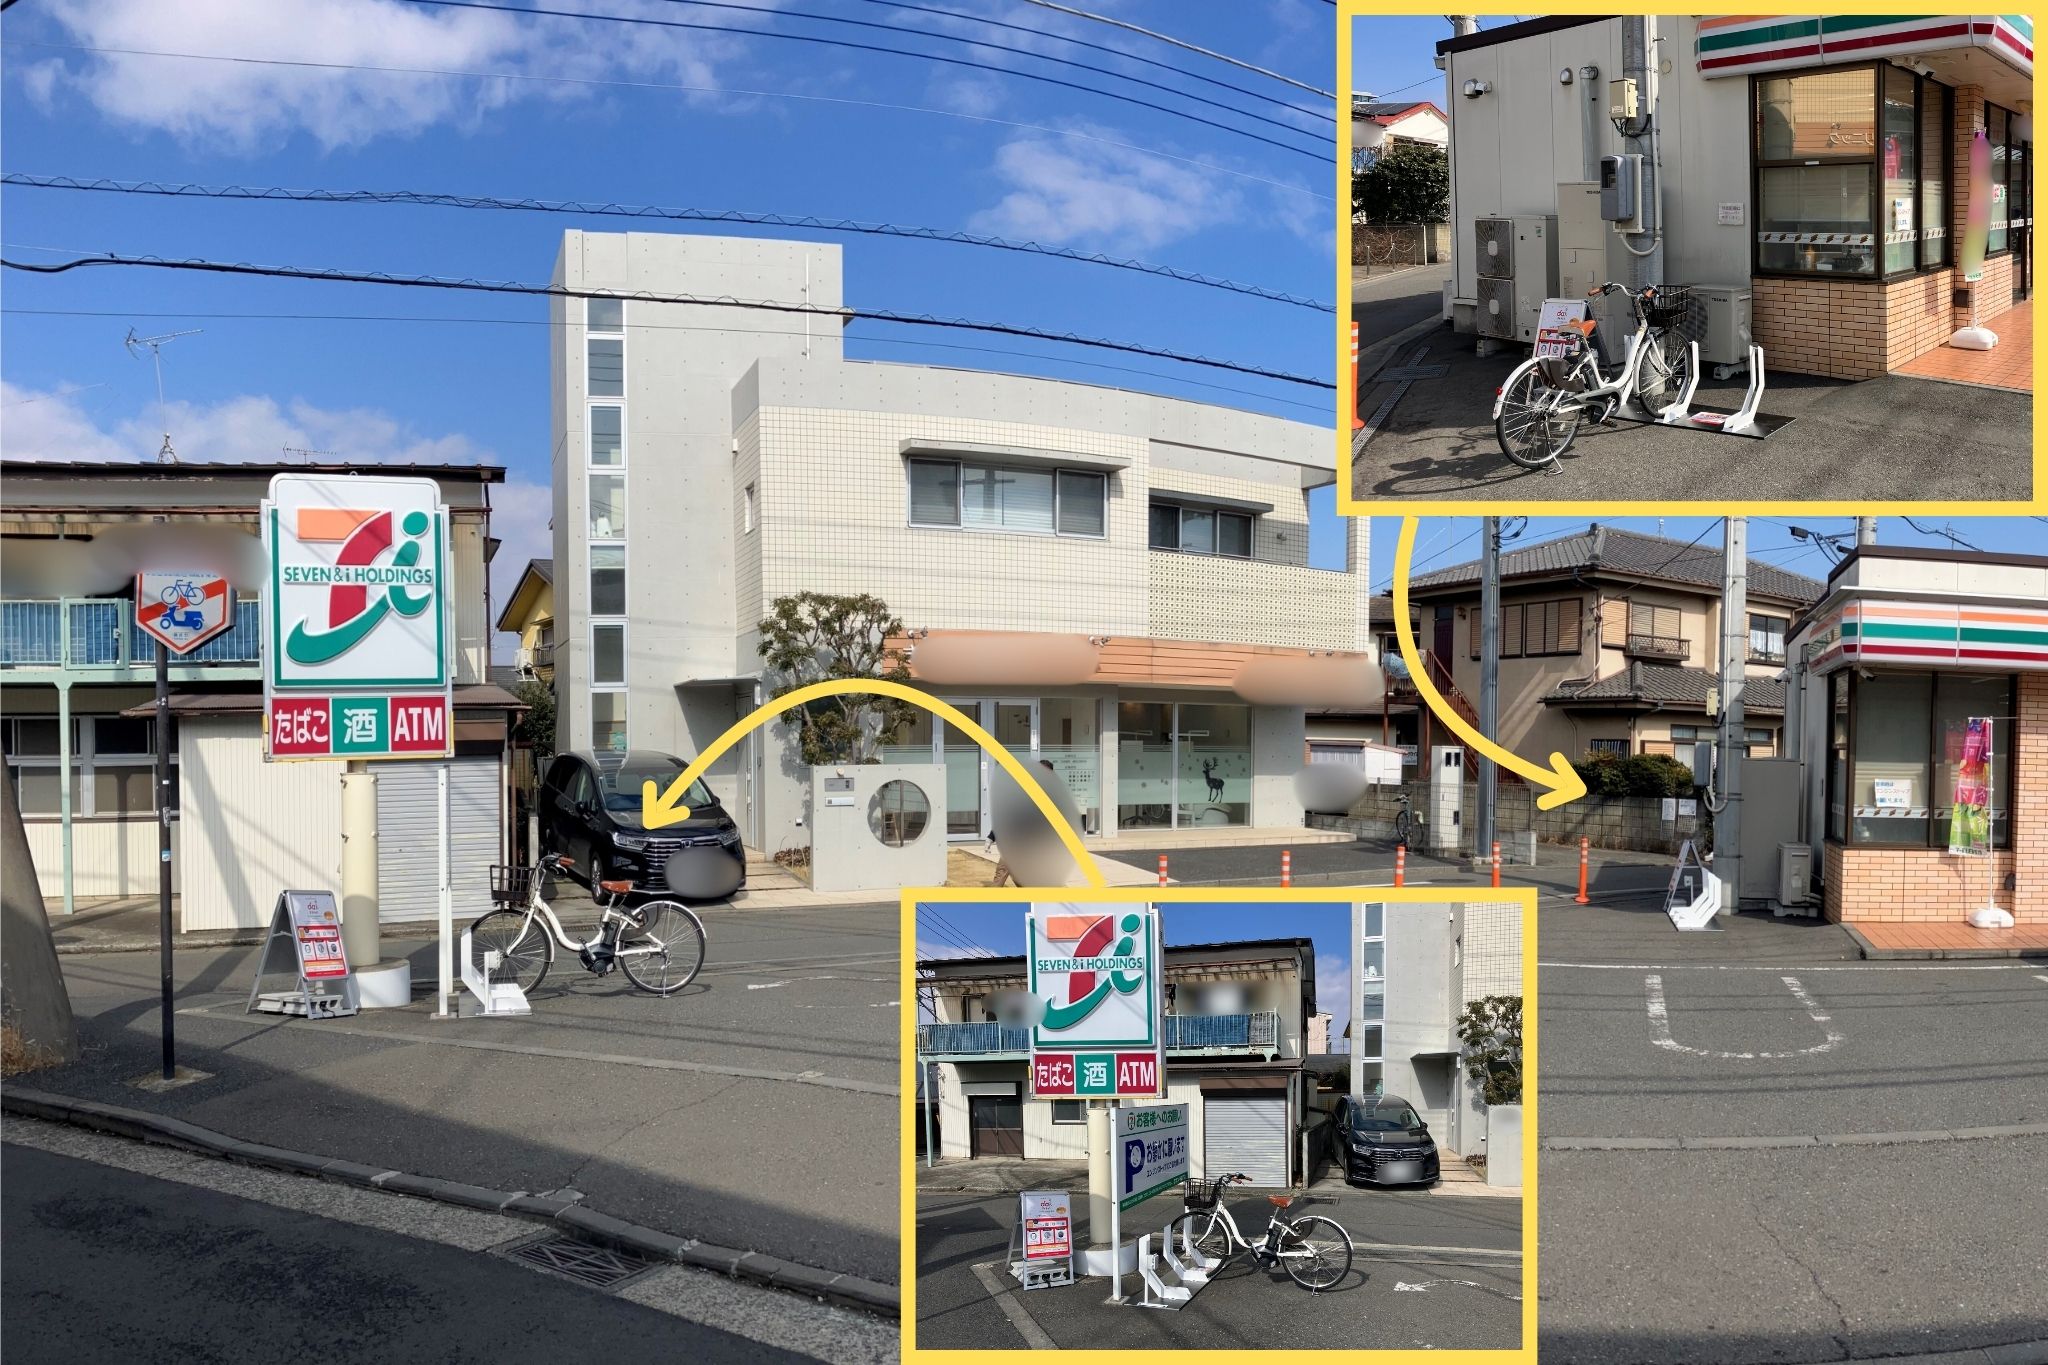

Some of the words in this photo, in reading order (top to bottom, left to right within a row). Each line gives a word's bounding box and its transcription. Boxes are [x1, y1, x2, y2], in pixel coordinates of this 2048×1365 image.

[355, 567, 432, 583] HOLDINGS
[275, 707, 329, 745] たばこ
[343, 708, 378, 744] 酒
[394, 706, 443, 742] ATM
[1087, 957, 1143, 970] HOLDINGS
[1037, 1061, 1073, 1087] たばこ
[1083, 1062, 1108, 1088] 酒
[1119, 1061, 1155, 1087] ATM
[1125, 1139, 1146, 1195] P
